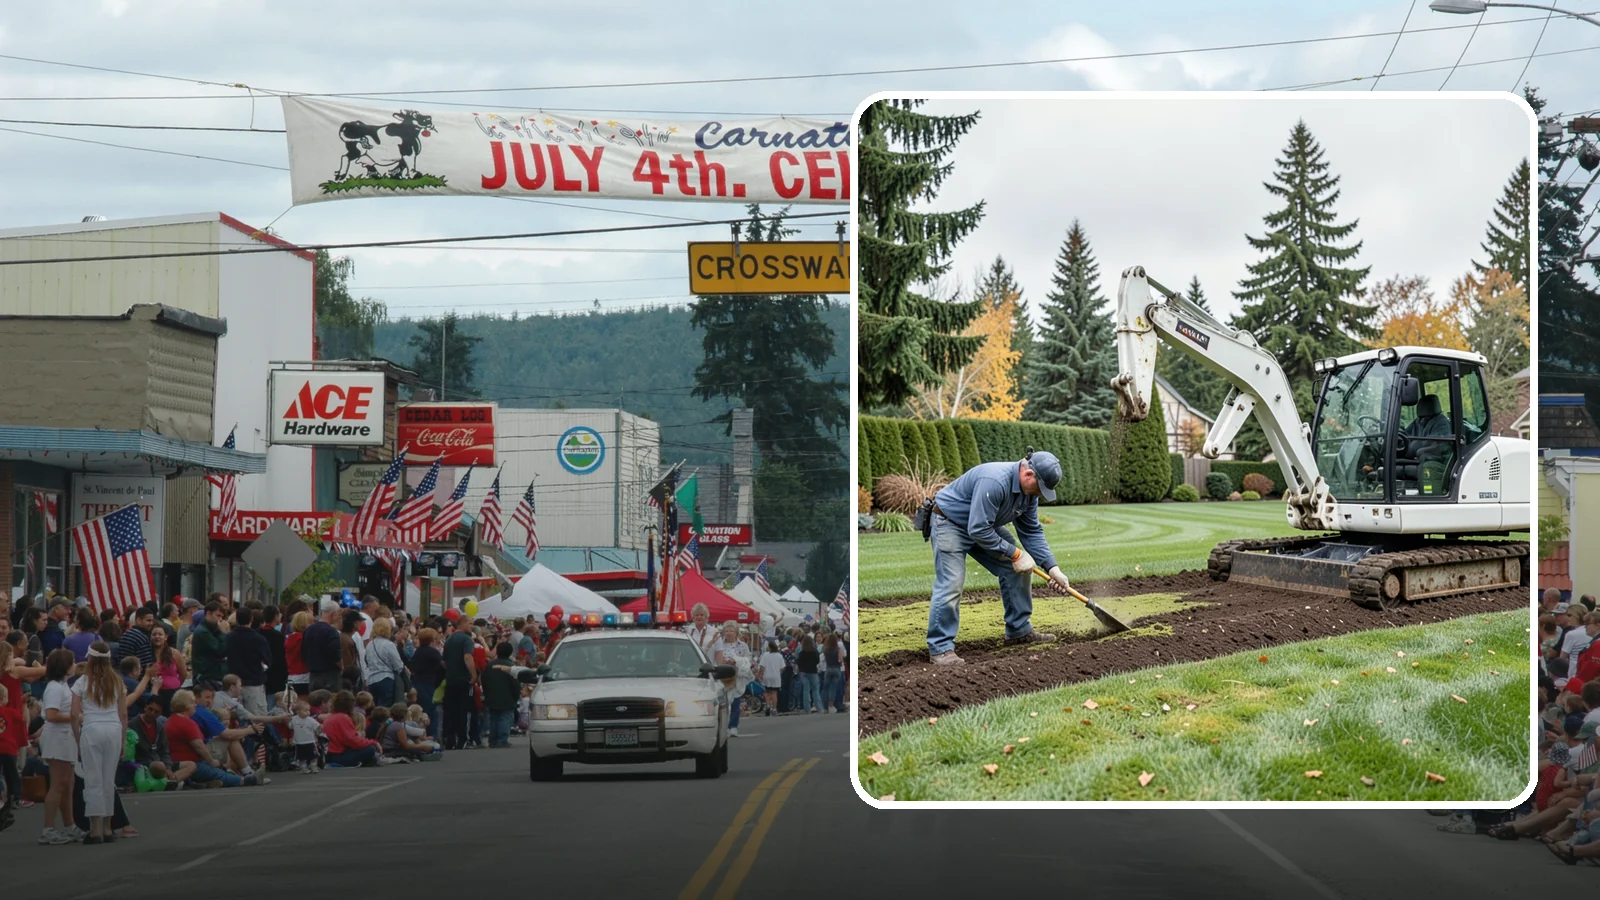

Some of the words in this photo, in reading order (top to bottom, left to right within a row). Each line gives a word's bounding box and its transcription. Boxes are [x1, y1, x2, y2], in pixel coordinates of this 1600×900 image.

[481, 141, 605, 192] JULY
[632, 150, 746, 198] 4th.
[697, 254, 850, 280] CROSSWA
[283, 380, 374, 420] ACE
[406, 409, 453, 422] CEDAR
[283, 421, 371, 436] Hardware
[83, 485, 94, 494] St.
[96, 485, 125, 495] Vincent
[126, 486, 136, 495] de
[138, 486, 155, 495] Paul
[688, 526, 742, 535] CRNATION
[699, 535, 730, 543] GLASS
